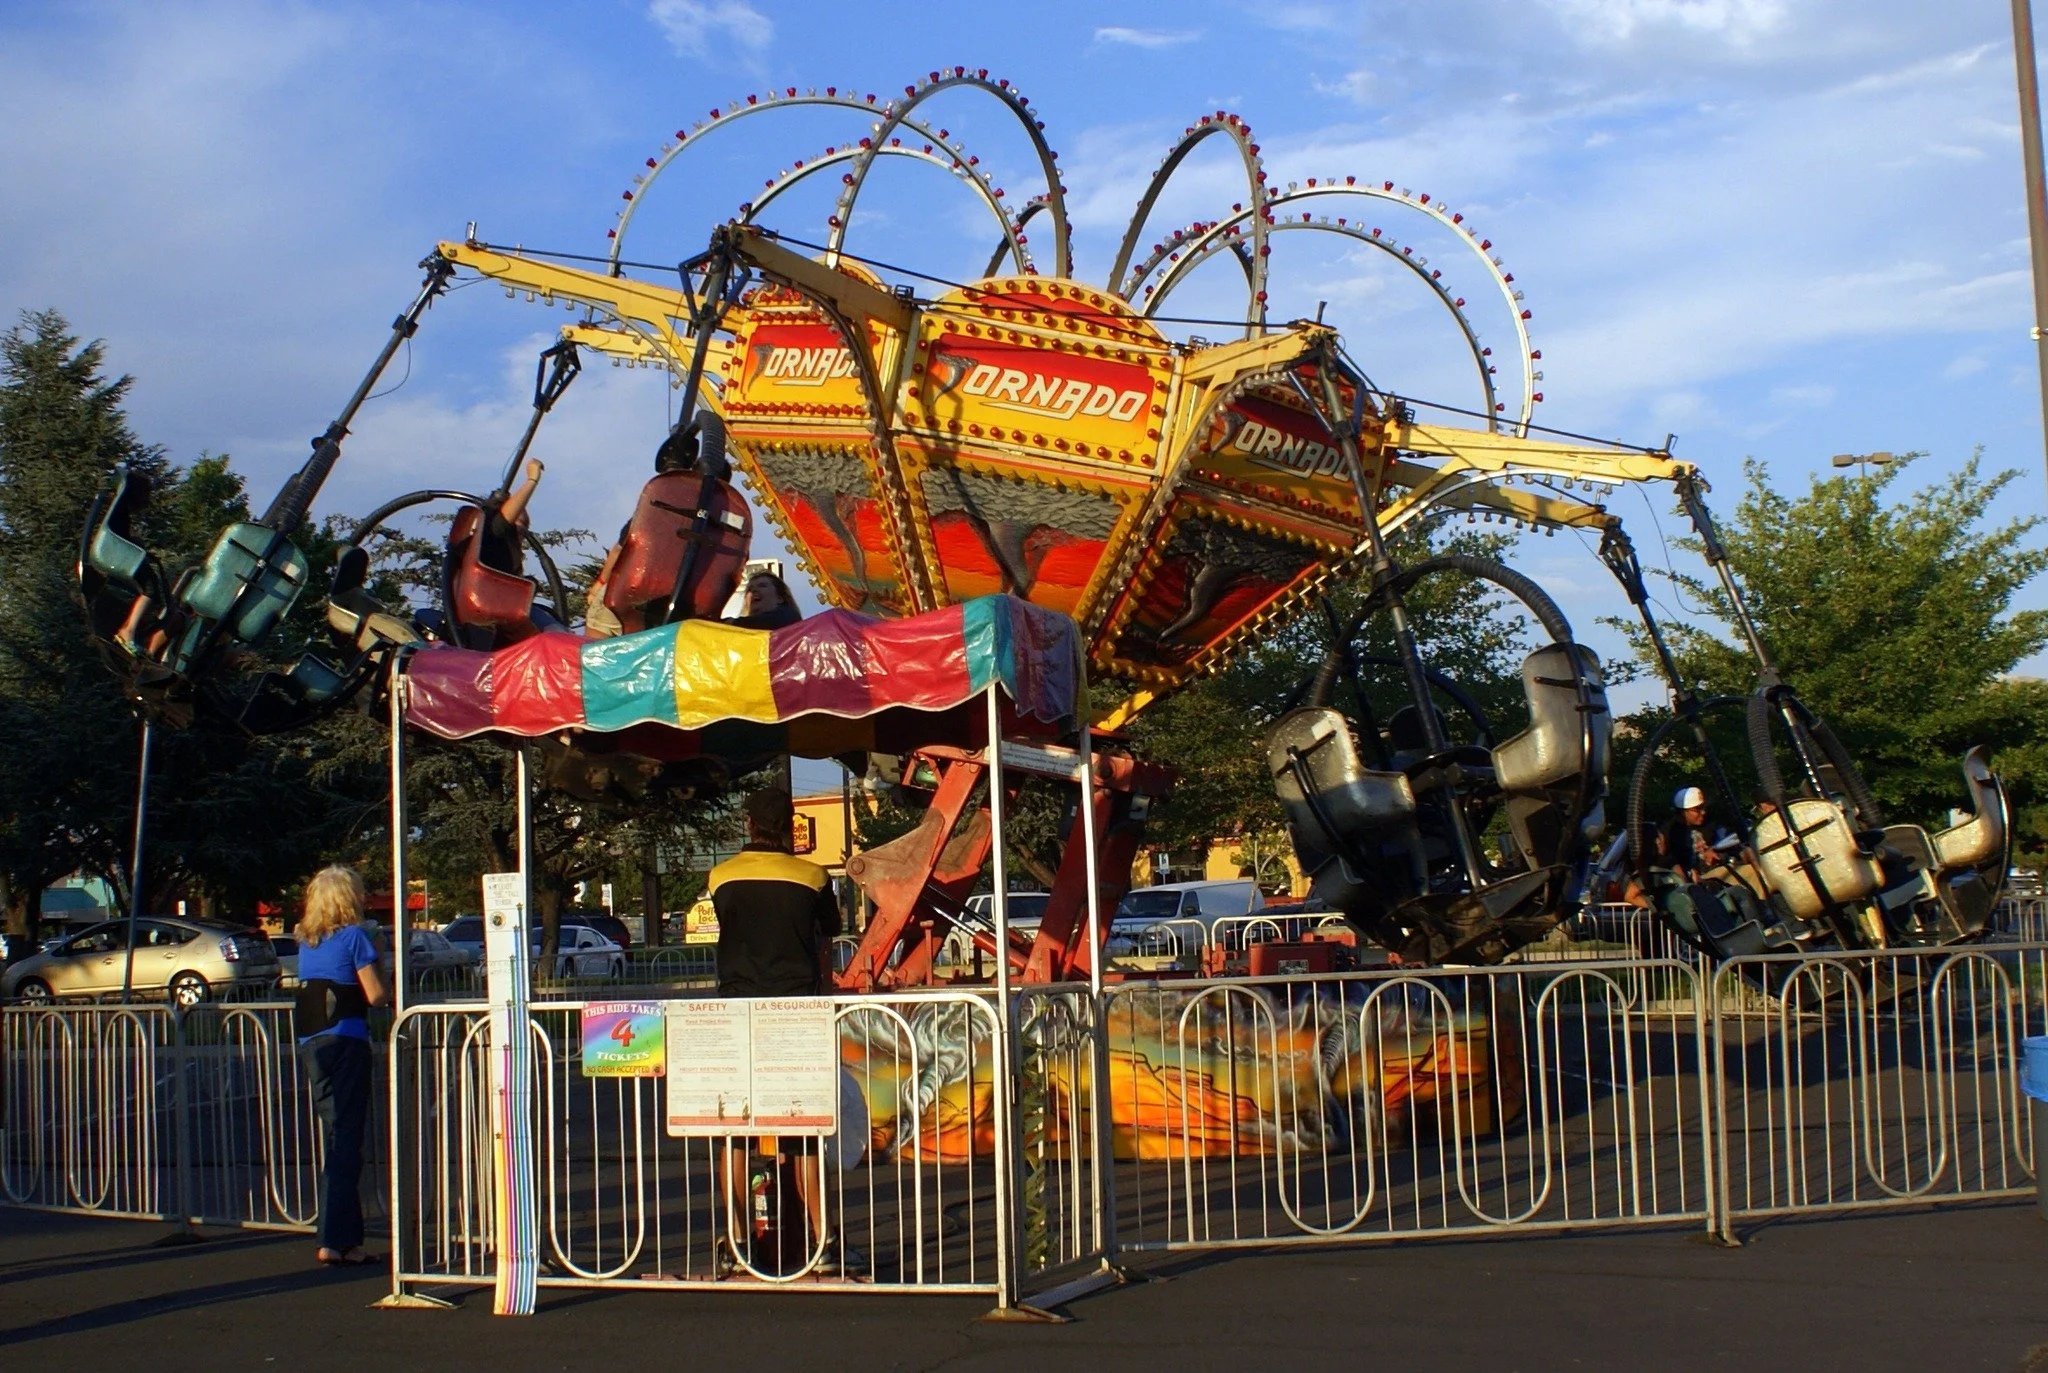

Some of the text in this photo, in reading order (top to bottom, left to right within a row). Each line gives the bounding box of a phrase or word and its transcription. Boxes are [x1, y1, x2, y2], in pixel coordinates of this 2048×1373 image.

[584, 1003, 661, 1018] THIS RIDE TAKES
[688, 1002, 728, 1012] SAFETY
[754, 1001, 830, 1011] LA SEGURIDAD
[609, 1019, 636, 1047] 4
[596, 1051, 650, 1061] TICKETS
[586, 1066, 596, 1074] NO
[616, 1065, 650, 1073] ACCEPTED
